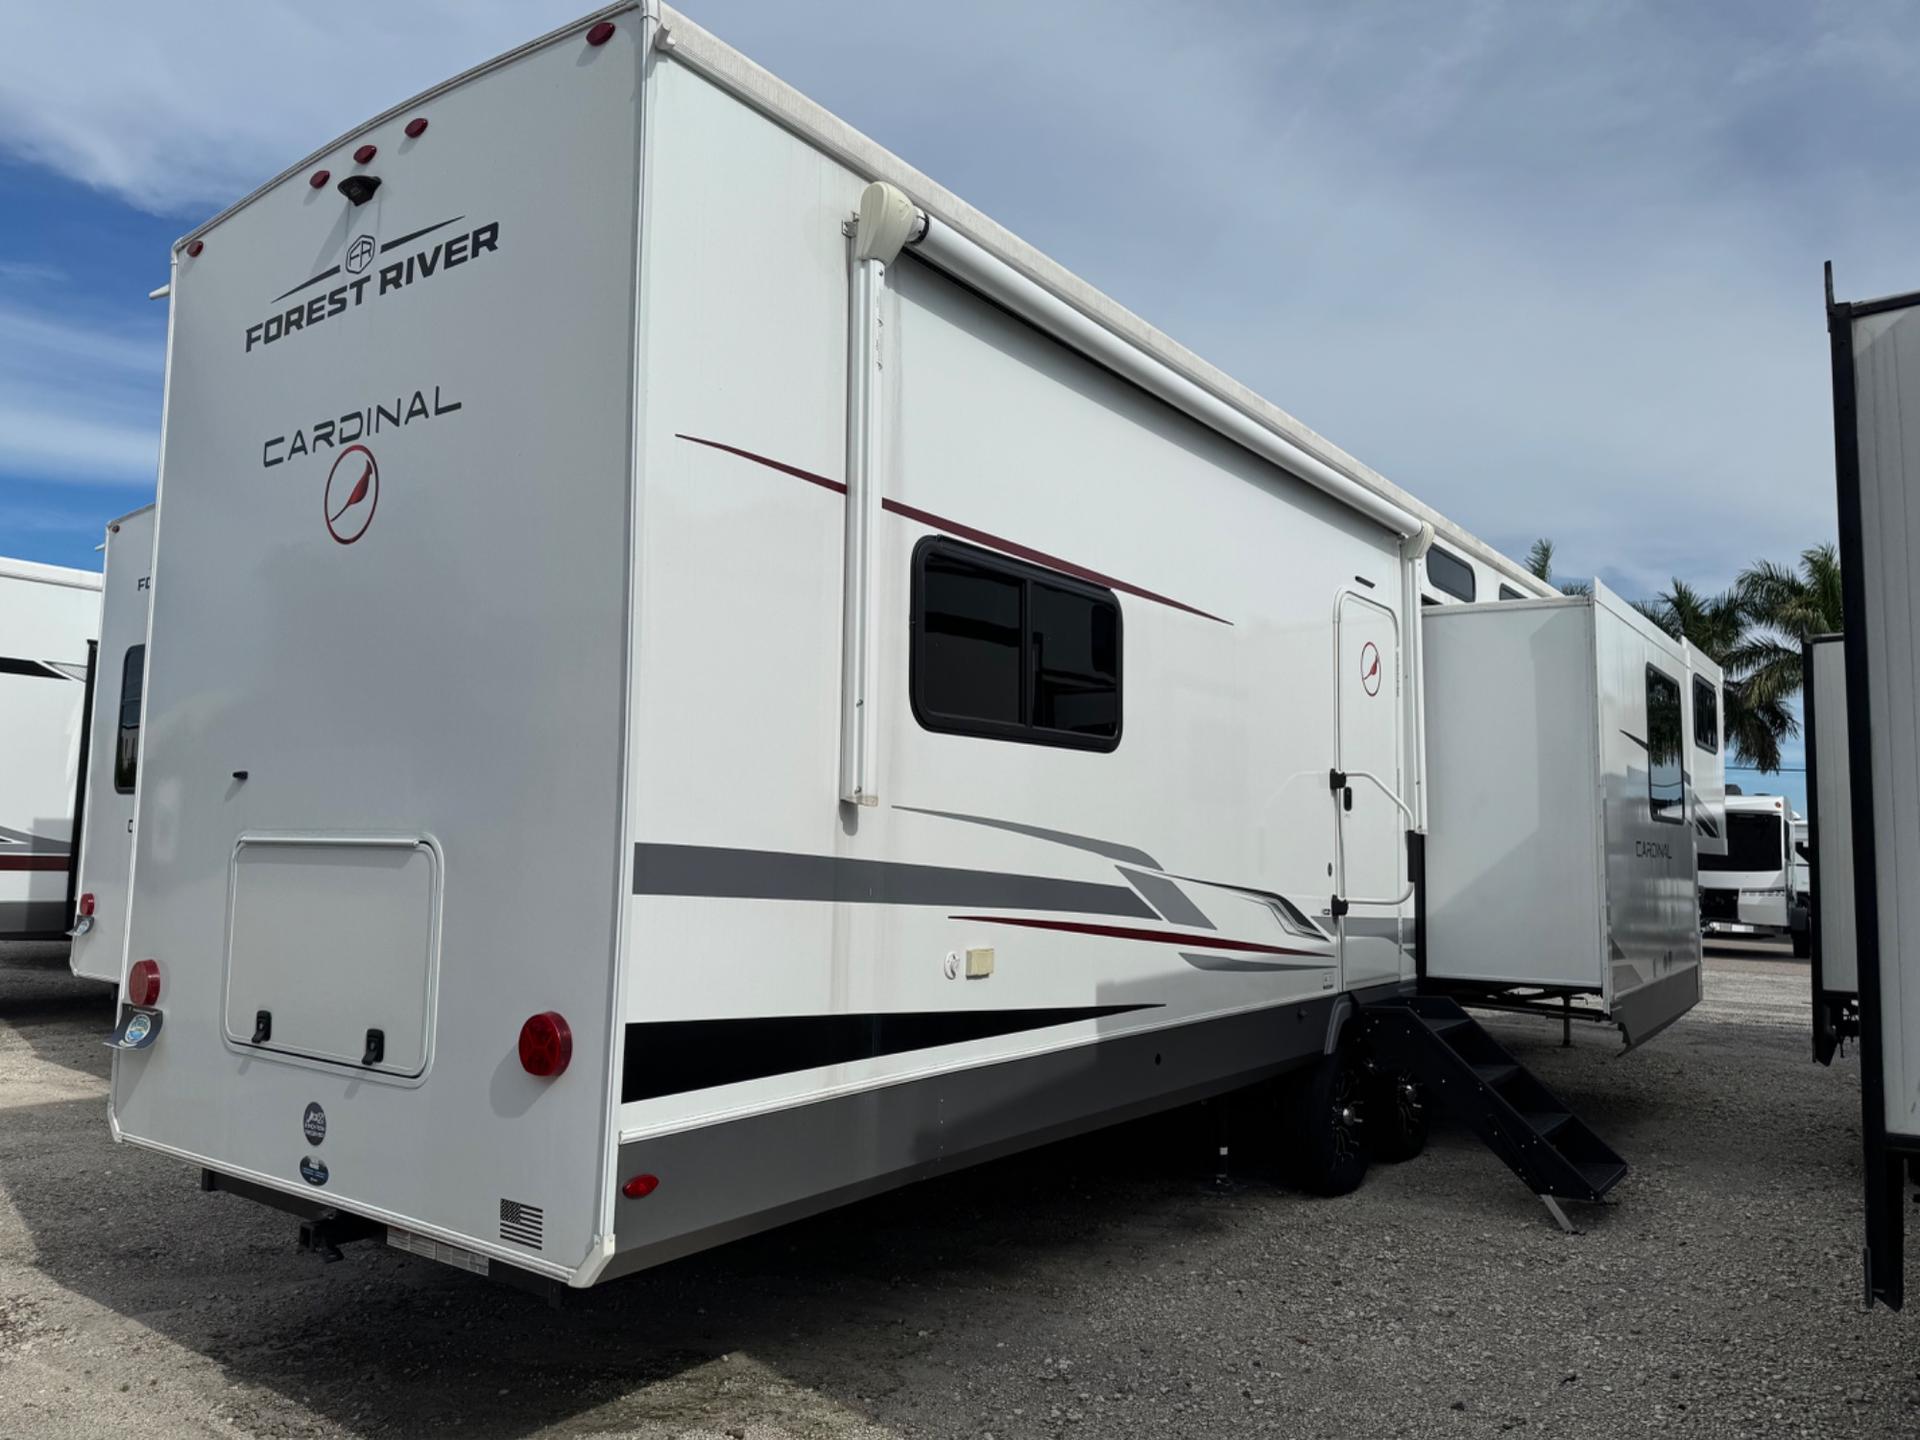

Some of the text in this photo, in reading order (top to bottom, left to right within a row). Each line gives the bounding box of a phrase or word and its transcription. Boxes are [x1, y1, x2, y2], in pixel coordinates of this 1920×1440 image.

[245, 221, 499, 353] FOREST RIVER
[263, 385, 462, 468] CARDINAL
[1635, 840, 1673, 860] CARDINAL
